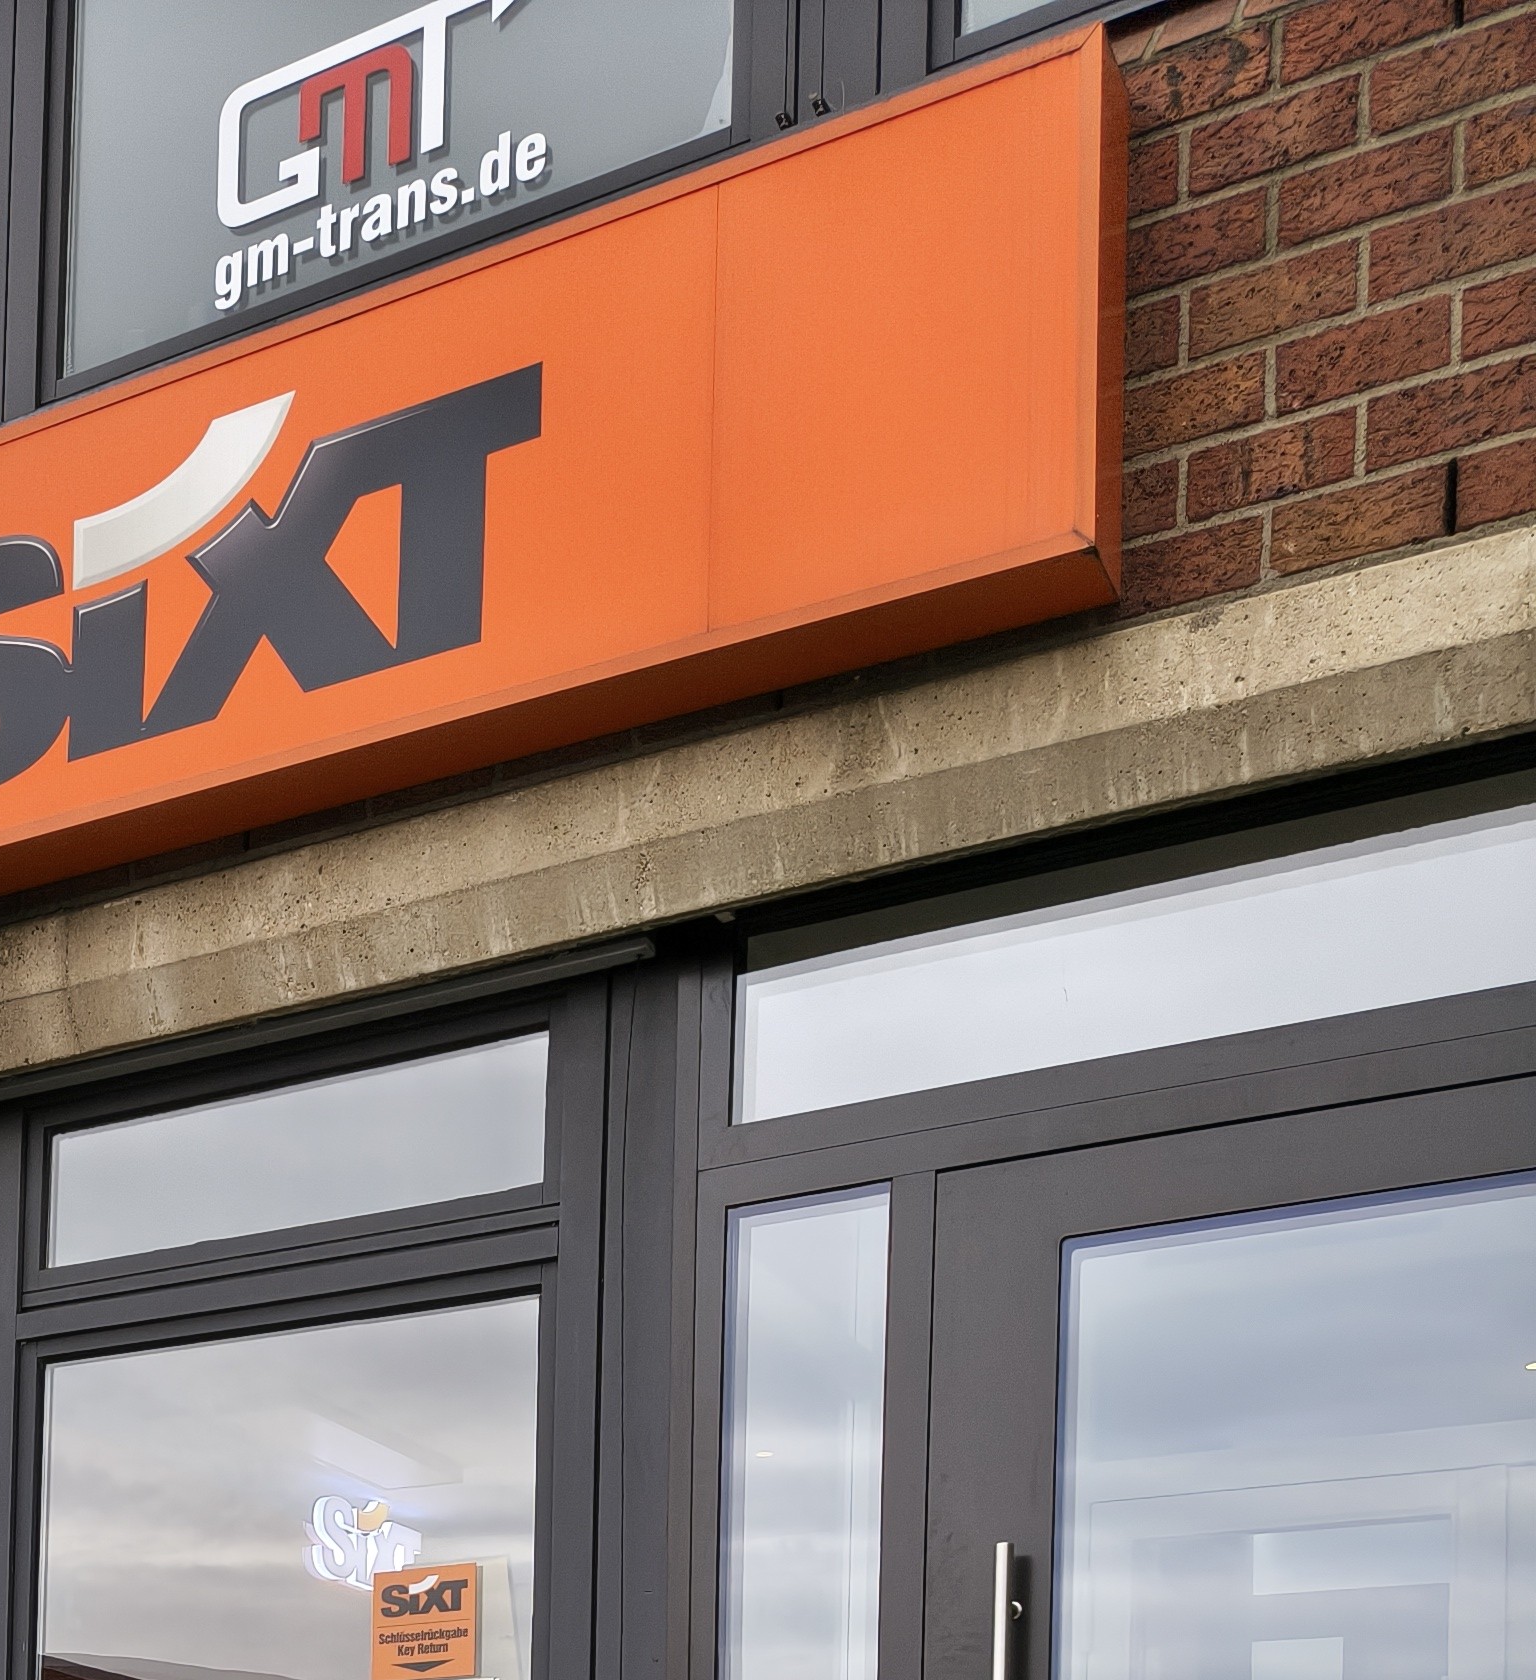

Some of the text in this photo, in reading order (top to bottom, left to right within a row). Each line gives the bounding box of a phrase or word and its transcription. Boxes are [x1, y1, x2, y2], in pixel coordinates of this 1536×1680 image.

[214, 131, 547, 310] gm-trans.de
[379, 1627, 468, 1644] Schlüsselrückgabe
[398, 1643, 448, 1656] Key Return
